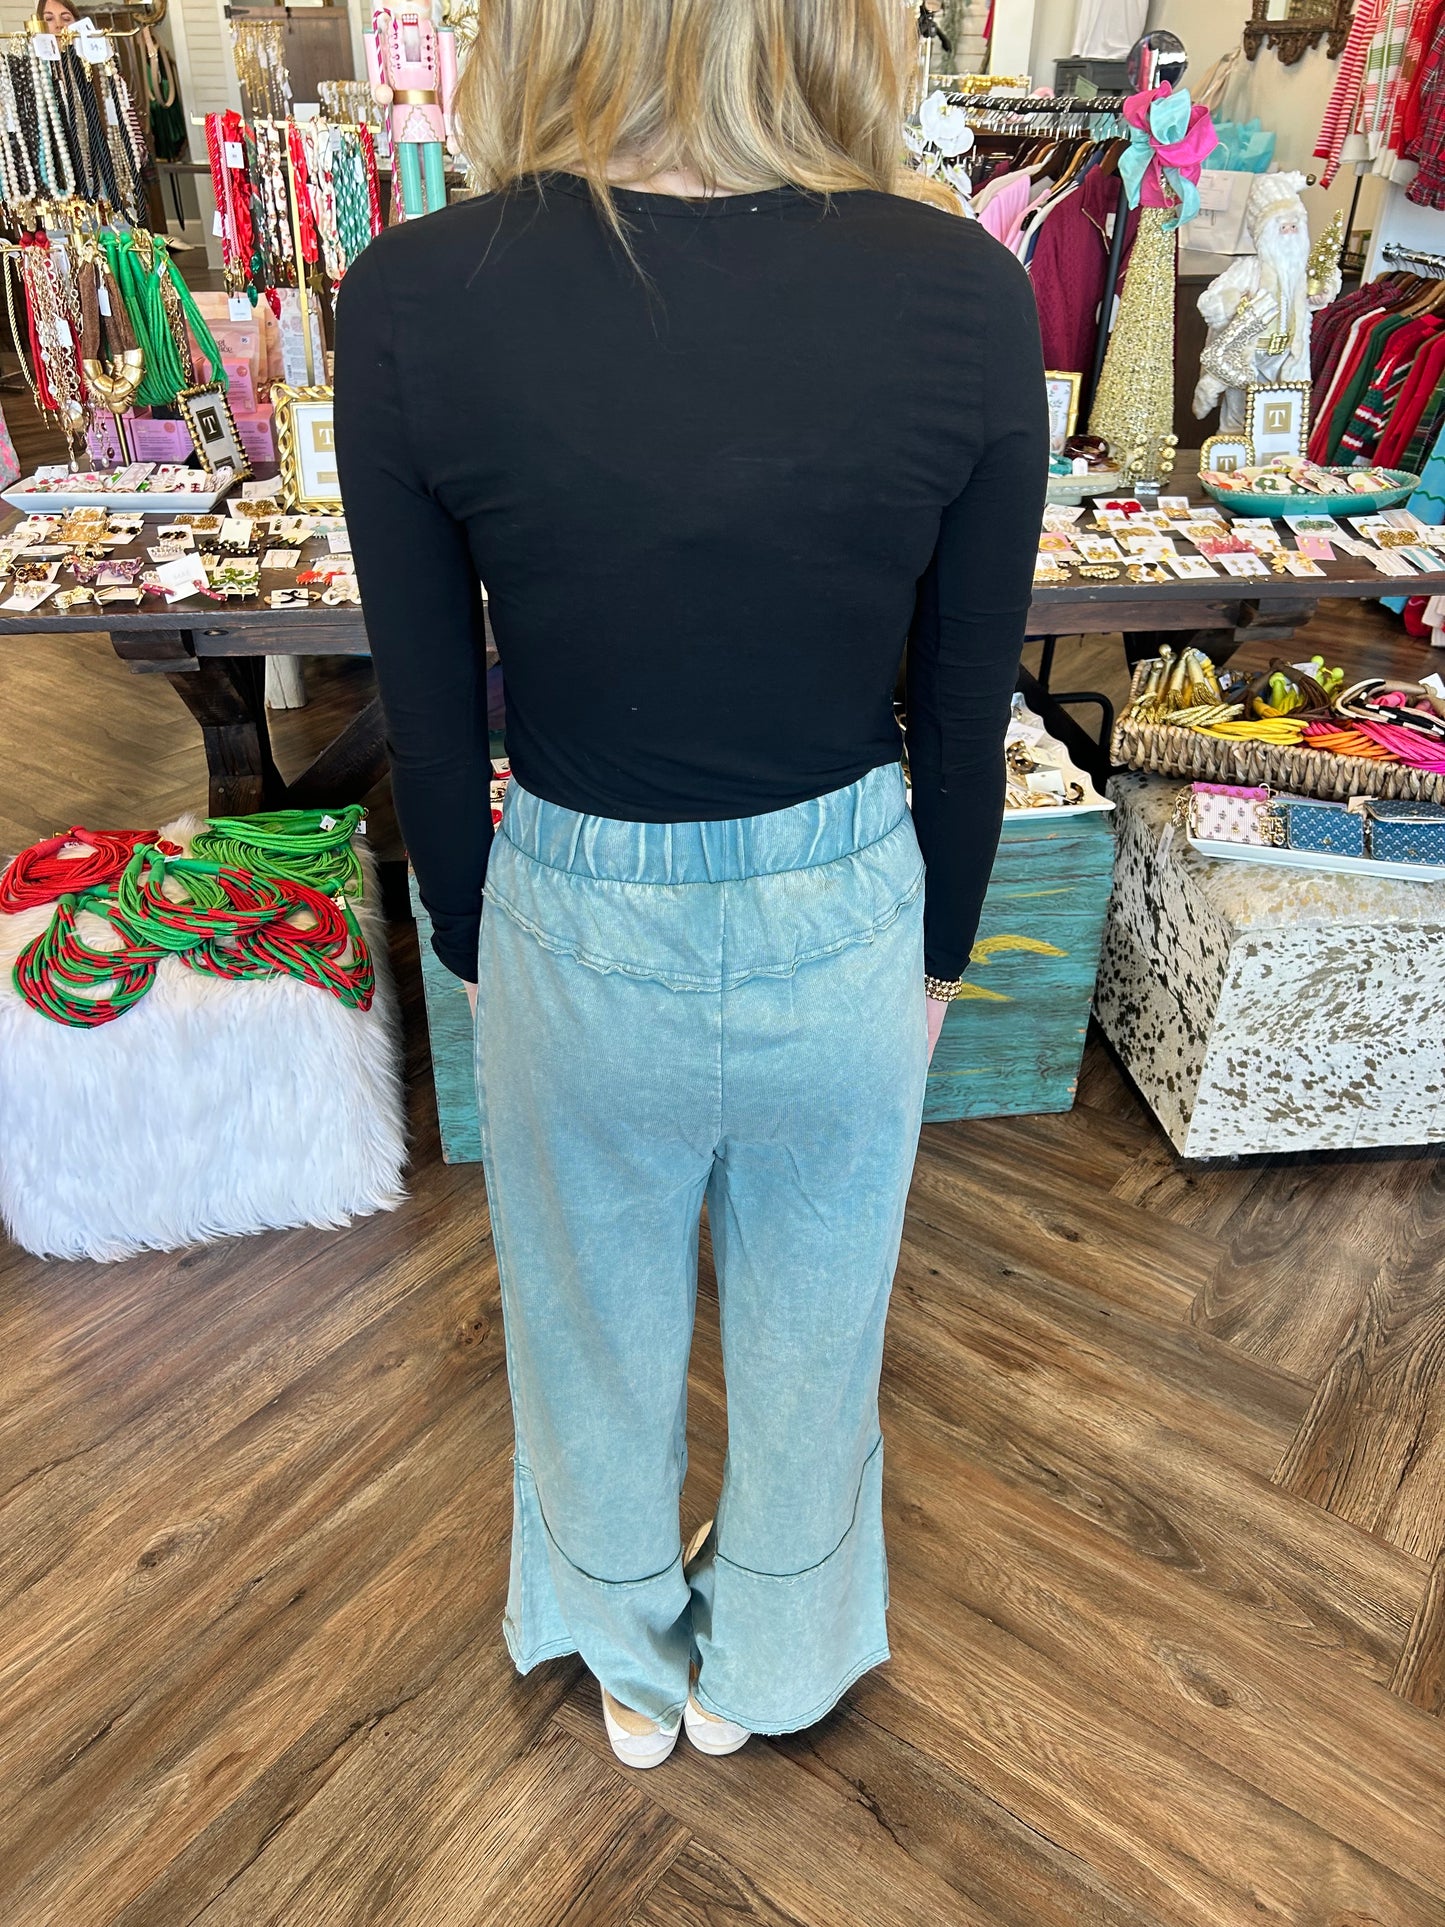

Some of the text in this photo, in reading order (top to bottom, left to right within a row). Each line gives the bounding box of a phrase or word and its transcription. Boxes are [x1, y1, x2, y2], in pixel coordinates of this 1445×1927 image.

[202, 415, 217, 435] T
[1269, 409, 1286, 428] T
[319, 428, 334, 446] T
[1220, 457, 1234, 471] T
